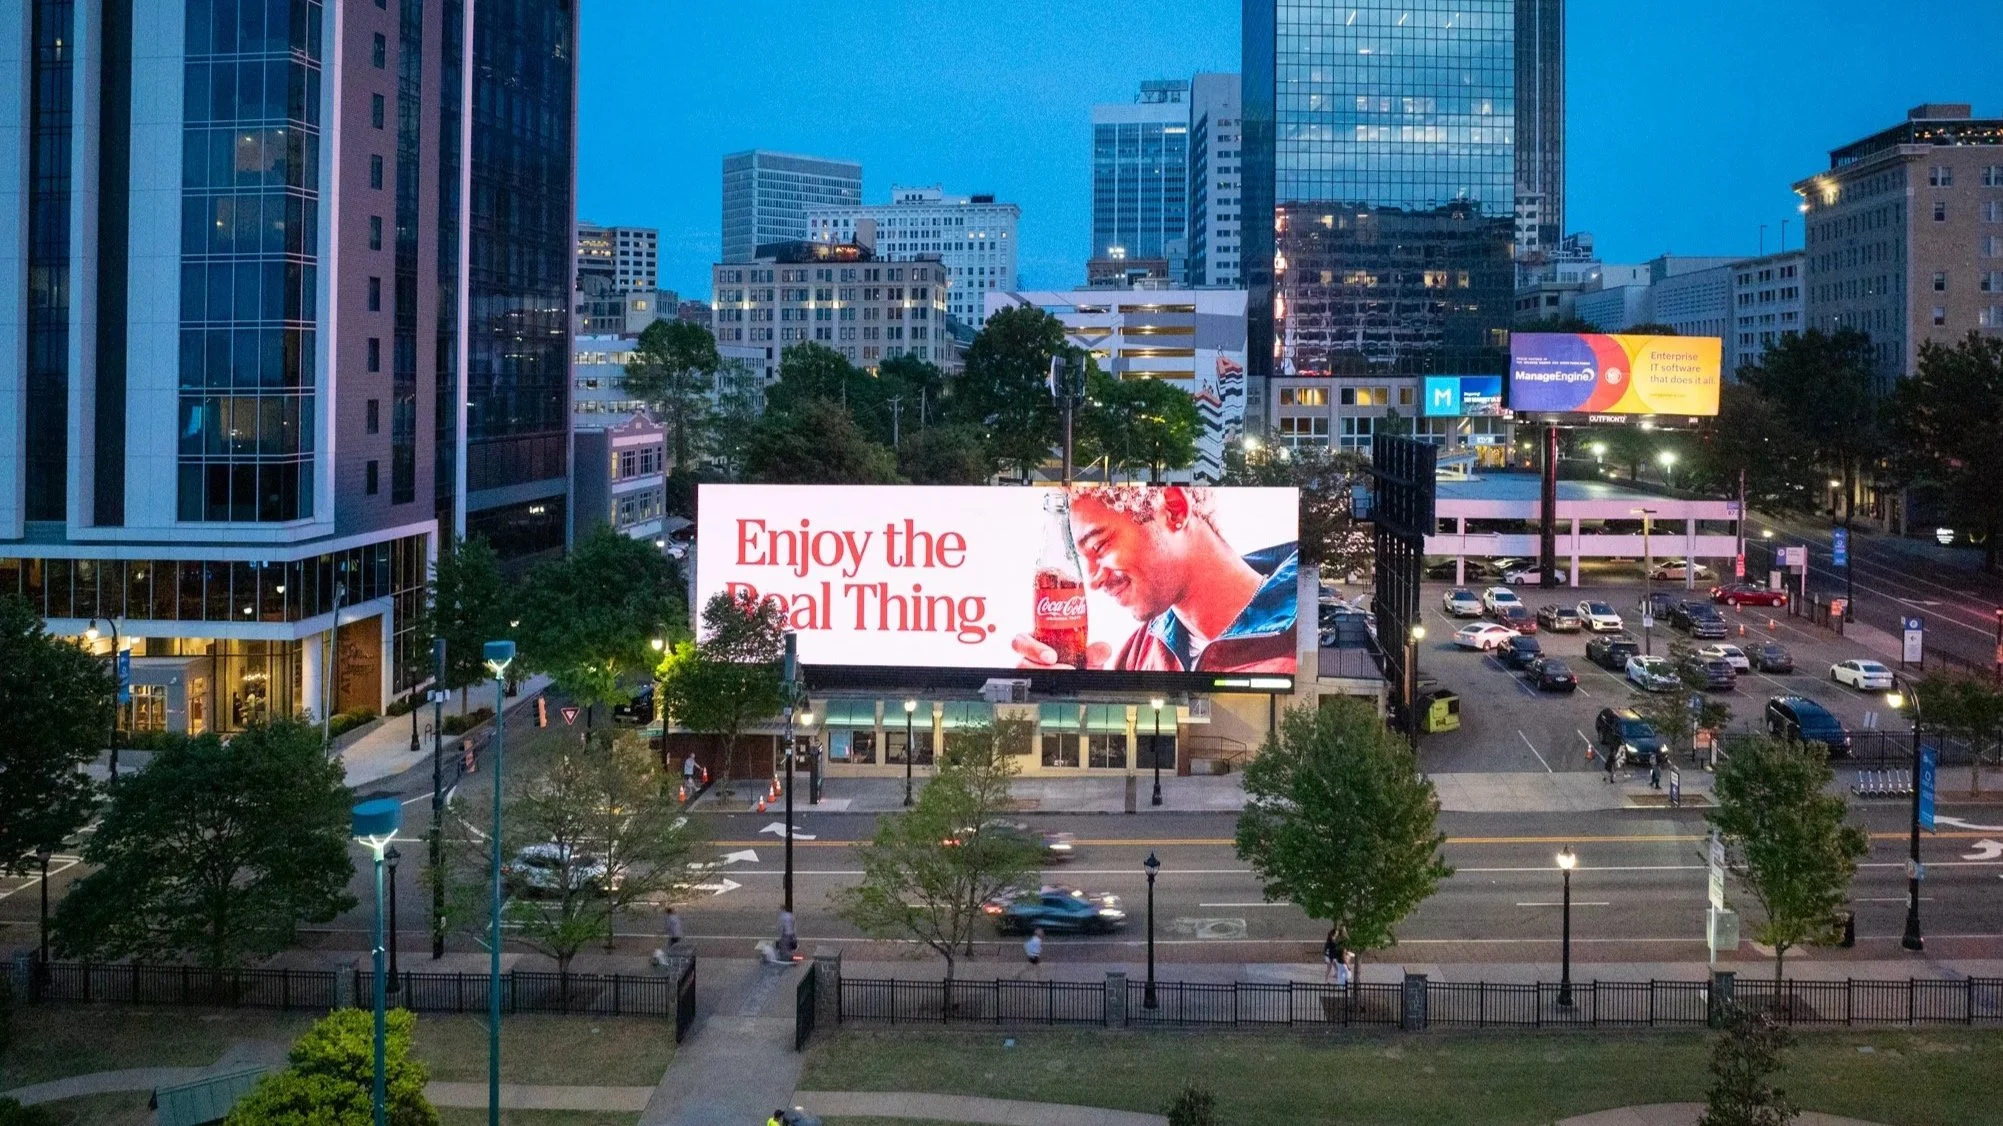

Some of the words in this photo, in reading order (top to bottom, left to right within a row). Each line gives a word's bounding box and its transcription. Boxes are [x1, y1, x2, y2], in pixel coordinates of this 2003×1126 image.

[1650, 351, 1698, 361] Enterprise
[1650, 363, 1658, 372] IT
[1661, 363, 1701, 373] software
[1515, 371, 1590, 383] ManageEngine
[1650, 375, 1668, 384] that
[1670, 375, 1693, 385] does
[1695, 376, 1701, 385] it
[1702, 376, 1716, 385] all.
[1434, 387, 1452, 408] M
[735, 518, 874, 577] Enjoy
[884, 518, 967, 568] the
[844, 581, 996, 644] Thing.
